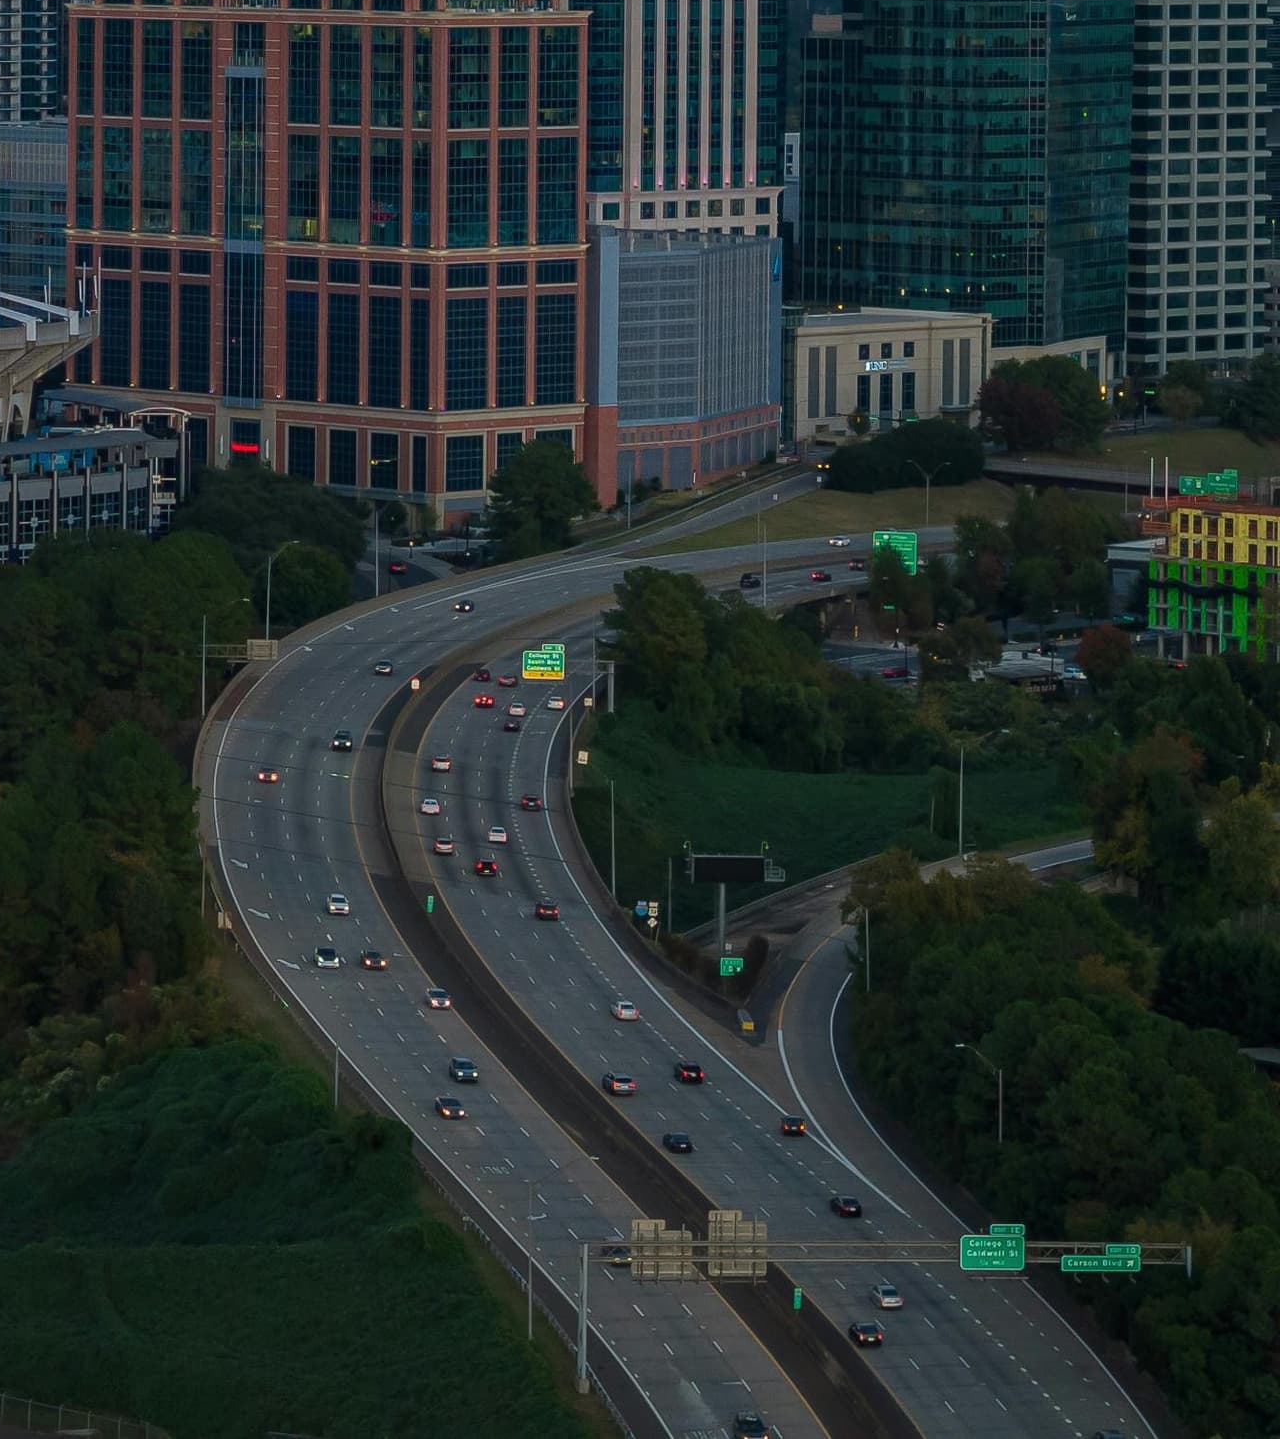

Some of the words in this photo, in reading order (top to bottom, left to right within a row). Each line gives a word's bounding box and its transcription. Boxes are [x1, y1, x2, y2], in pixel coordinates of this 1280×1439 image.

[969, 1239, 1002, 1248] College
[1006, 1239, 1017, 1247] St
[966, 1249, 1005, 1257] Caldwell
[1008, 1249, 1019, 1257] St
[1067, 1259, 1098, 1267] Carson
[1102, 1259, 1122, 1267] Blvd
